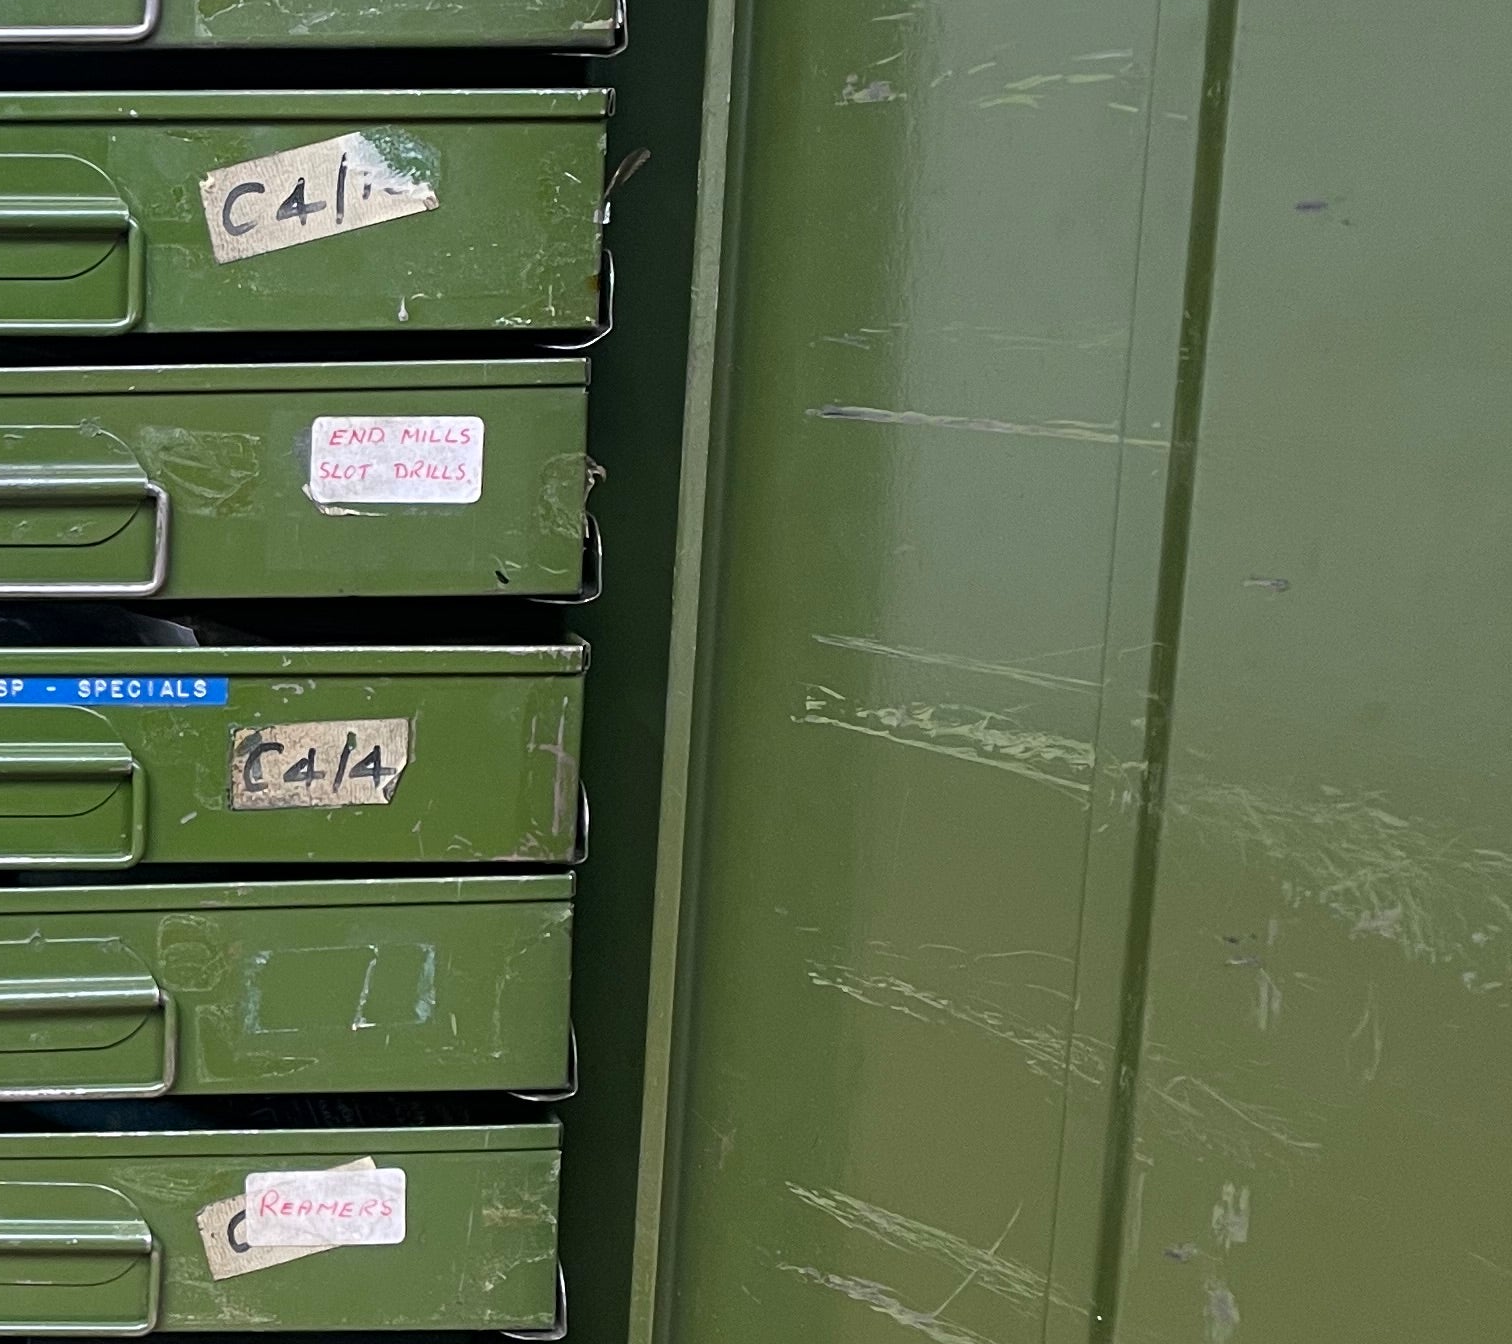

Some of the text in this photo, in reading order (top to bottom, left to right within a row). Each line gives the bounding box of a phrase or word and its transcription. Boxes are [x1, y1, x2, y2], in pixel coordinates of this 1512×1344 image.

[328, 427, 471, 446] END MILLS
[319, 461, 373, 480] SLOT
[77, 677, 207, 698] SPECIALS
[259, 1189, 393, 1218] REAMERS
